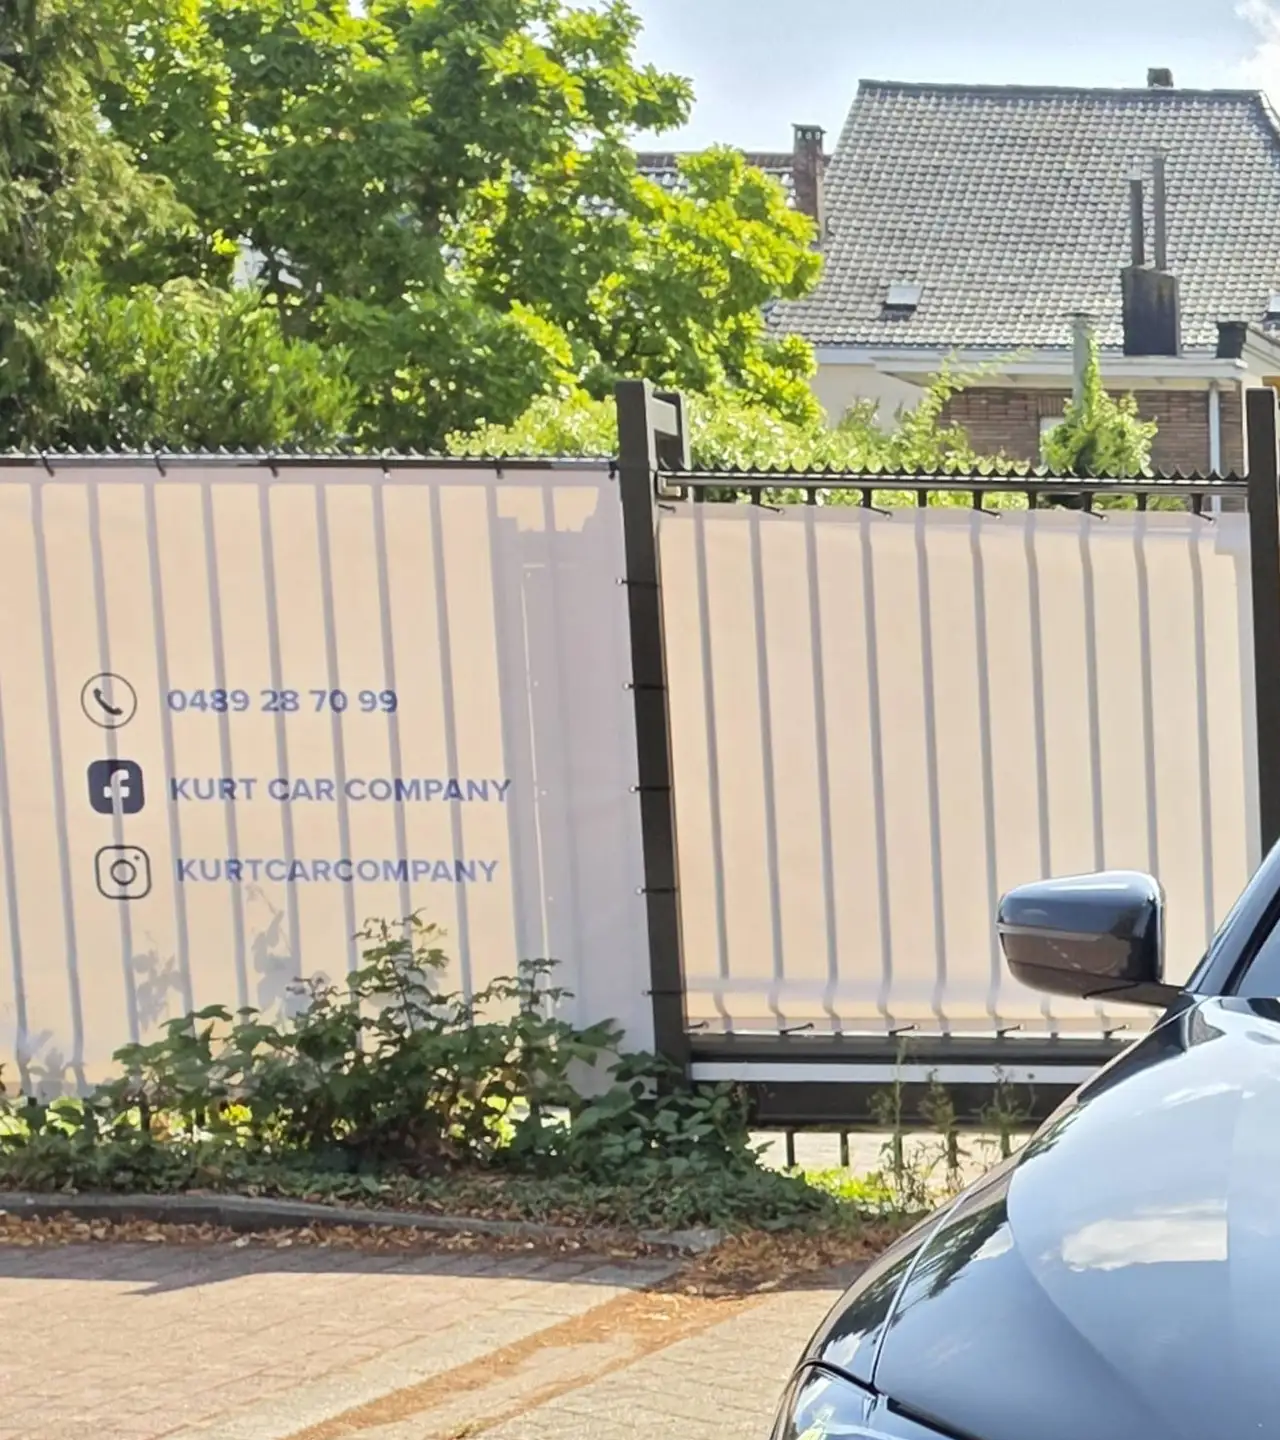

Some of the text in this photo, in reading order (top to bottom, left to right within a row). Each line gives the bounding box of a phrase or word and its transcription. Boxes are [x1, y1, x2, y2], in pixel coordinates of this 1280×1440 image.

[166, 688, 399, 713] 0489 28 70 99
[170, 777, 512, 801] KURT CAR COMPANY
[176, 857, 500, 883] KURTCARCOMPANY
